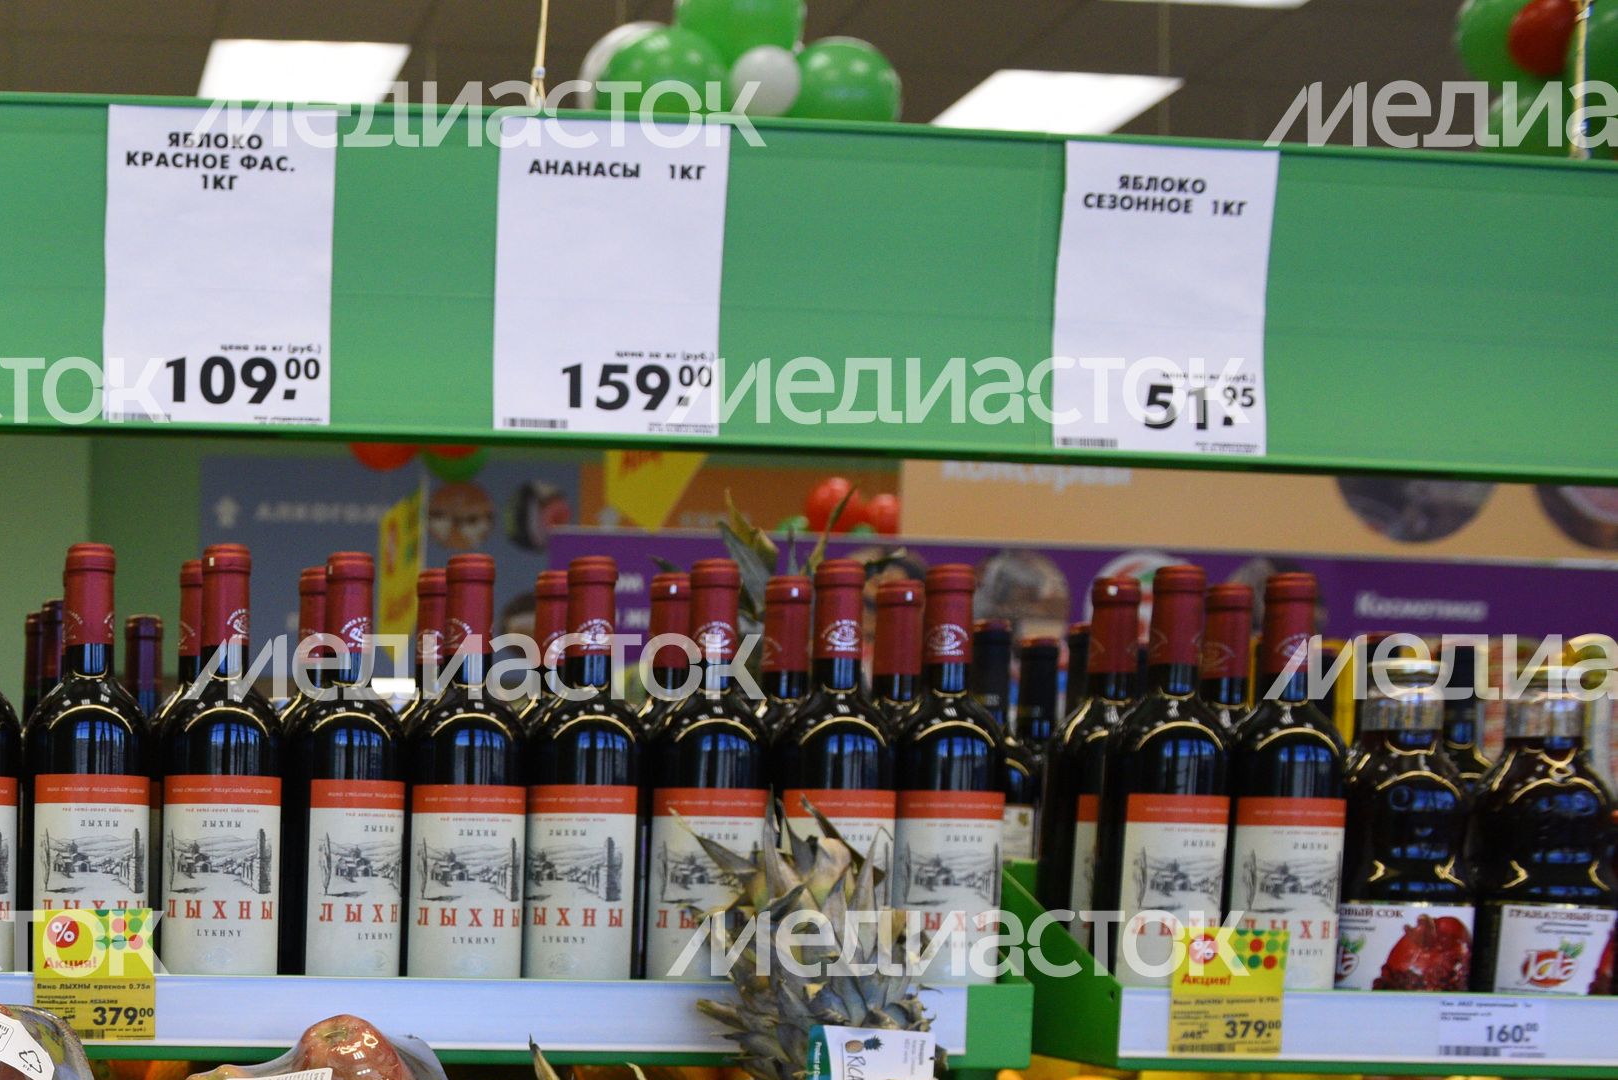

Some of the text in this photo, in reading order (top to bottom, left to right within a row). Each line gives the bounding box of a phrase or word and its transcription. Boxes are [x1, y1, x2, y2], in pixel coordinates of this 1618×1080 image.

[168, 131, 263, 150] ЯБЛОКО
[126, 151, 296, 172] КРАСНОЕ ФАС.
[528, 158, 706, 180] АНАНАСЫ 1КГ
[201, 173, 238, 190] 1КГ
[1118, 174, 1207, 195] ЯБЛОКО
[1083, 192, 1248, 216] СЕЗОННОЕ 1КГ
[167, 899, 273, 920] ЛЫХНЫ
[319, 903, 398, 923] ЛЫХН
[197, 928, 242, 937] LYKHNY
[452, 935, 497, 944] LYKHNY
[43, 957, 97, 971] Акция!
[1181, 973, 1232, 986] Акция!
[814, 1041, 822, 1063] Product
